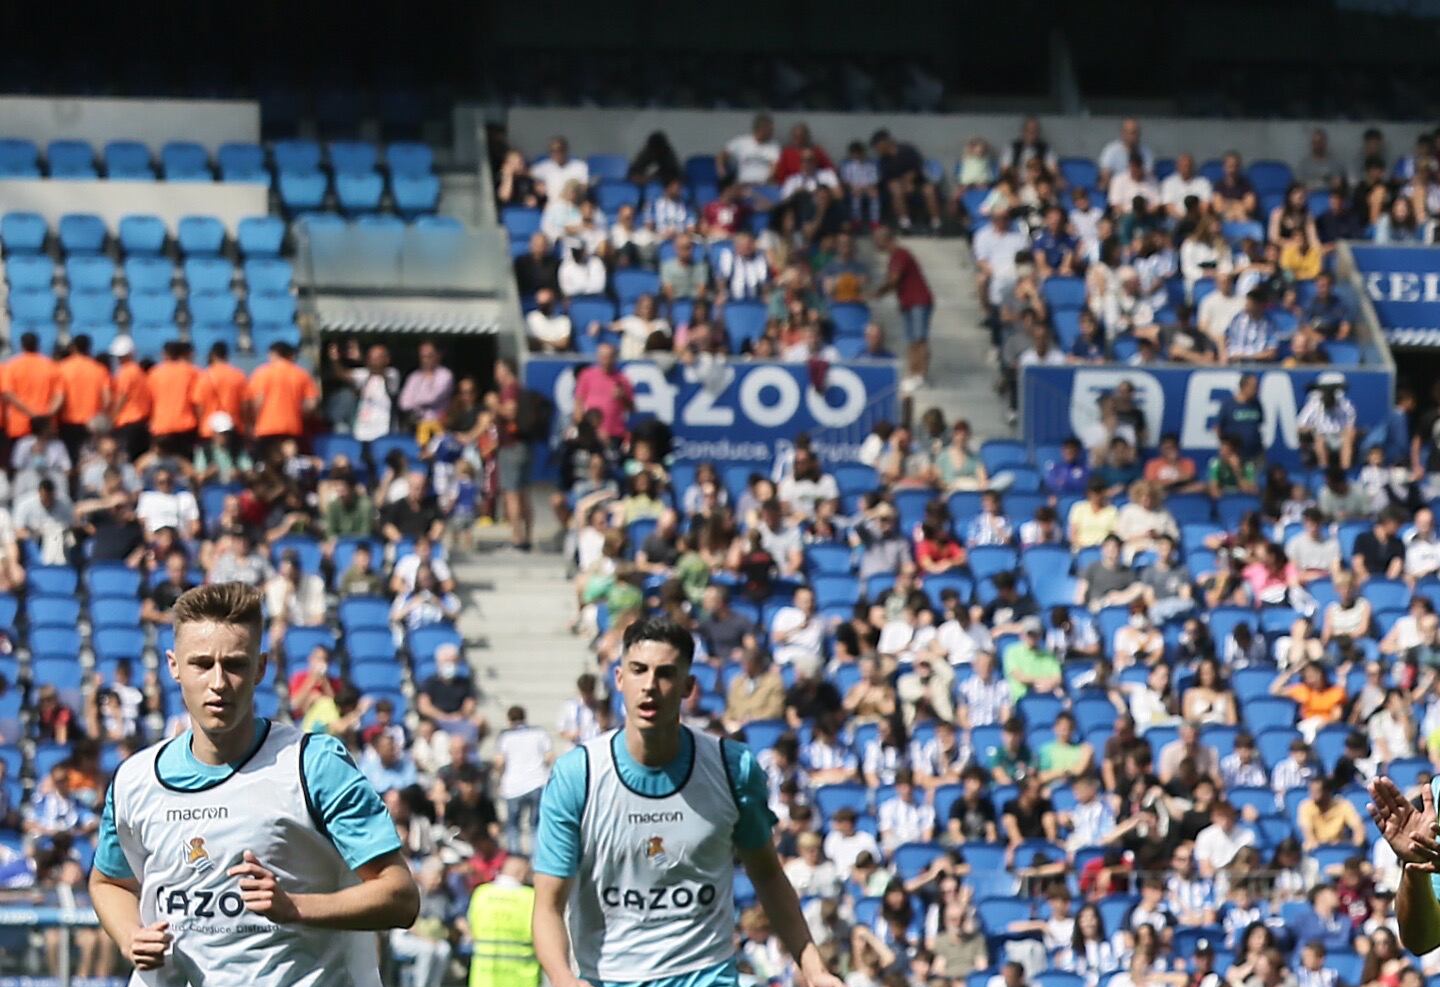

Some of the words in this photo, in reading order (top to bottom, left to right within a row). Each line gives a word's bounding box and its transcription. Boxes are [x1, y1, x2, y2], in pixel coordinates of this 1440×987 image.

[166, 806, 229, 822] macron
[628, 811, 684, 824] macron
[157, 886, 246, 918] AZO
[602, 883, 716, 911] CAZOO
